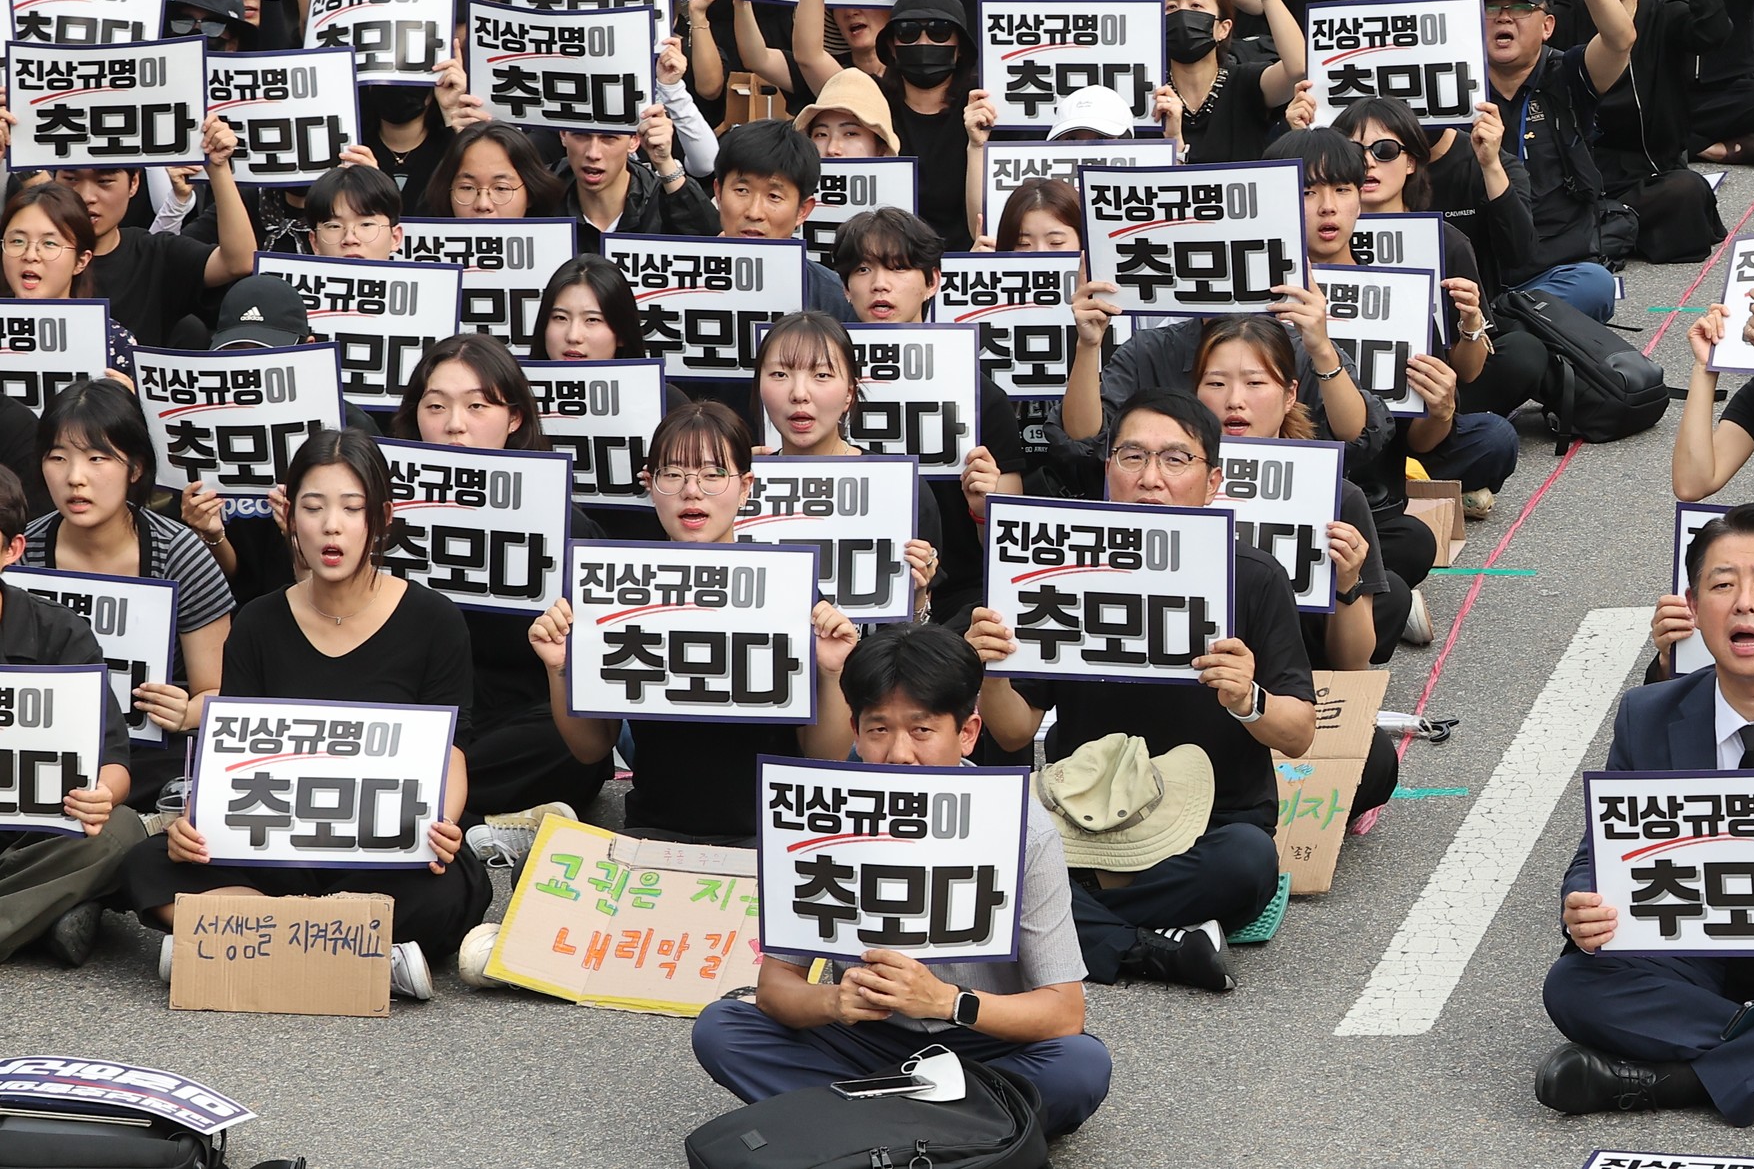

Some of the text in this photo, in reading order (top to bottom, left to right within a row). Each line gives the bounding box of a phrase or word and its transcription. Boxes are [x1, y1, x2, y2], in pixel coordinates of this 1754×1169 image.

[474, 15, 616, 58] 진상규명이
[988, 14, 1126, 46] 진상규명이
[1313, 14, 1447, 49] 진상규명이
[15, 57, 166, 93] 진상규명이
[489, 68, 653, 123] 추모다
[34, 102, 197, 157] 추모다
[1091, 183, 1257, 222] 진상규명이
[611, 251, 763, 292] 진상규명이
[1115, 237, 1293, 304] 추모다
[142, 366, 297, 404] 진상규명이
[995, 519, 1180, 571] 진상규명이
[579, 561, 767, 608] 진상규명이
[1014, 585, 1219, 666] 추모다
[600, 629, 802, 707] 추모다
[212, 716, 402, 757] 진상규명이
[225, 772, 430, 852] 추모다
[769, 782, 970, 840] 진상규명이
[536, 853, 662, 916] 교권은
[792, 857, 1006, 946] 추모다
[194, 915, 385, 961] 선생님을 지켜주세요
